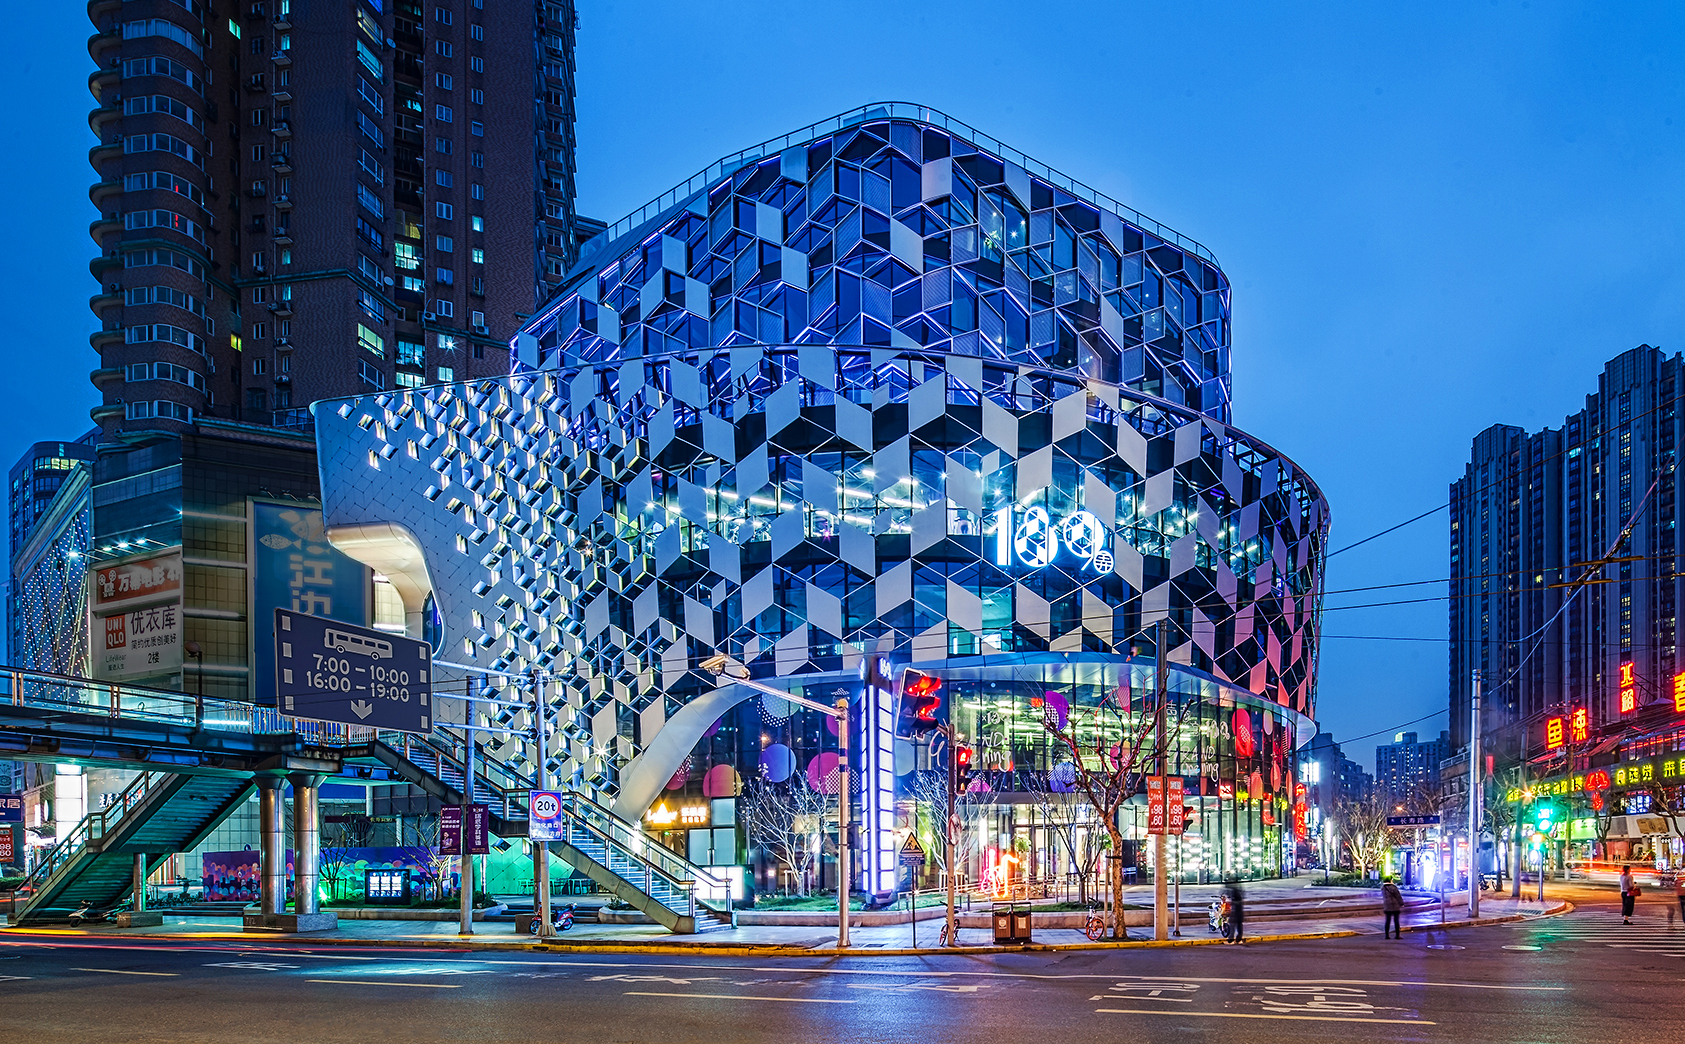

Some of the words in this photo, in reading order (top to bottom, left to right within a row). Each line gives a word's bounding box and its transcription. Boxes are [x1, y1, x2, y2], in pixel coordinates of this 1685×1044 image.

[106, 617, 123, 632] UNI
[130, 605, 177, 635] 优衣库
[107, 631, 125, 647] QLO
[313, 653, 350, 675] 7:00
[369, 664, 410, 686] 10:00
[306, 670, 351, 693] 16:00
[370, 681, 410, 703] 19:00
[537, 800, 556, 812] 20t
